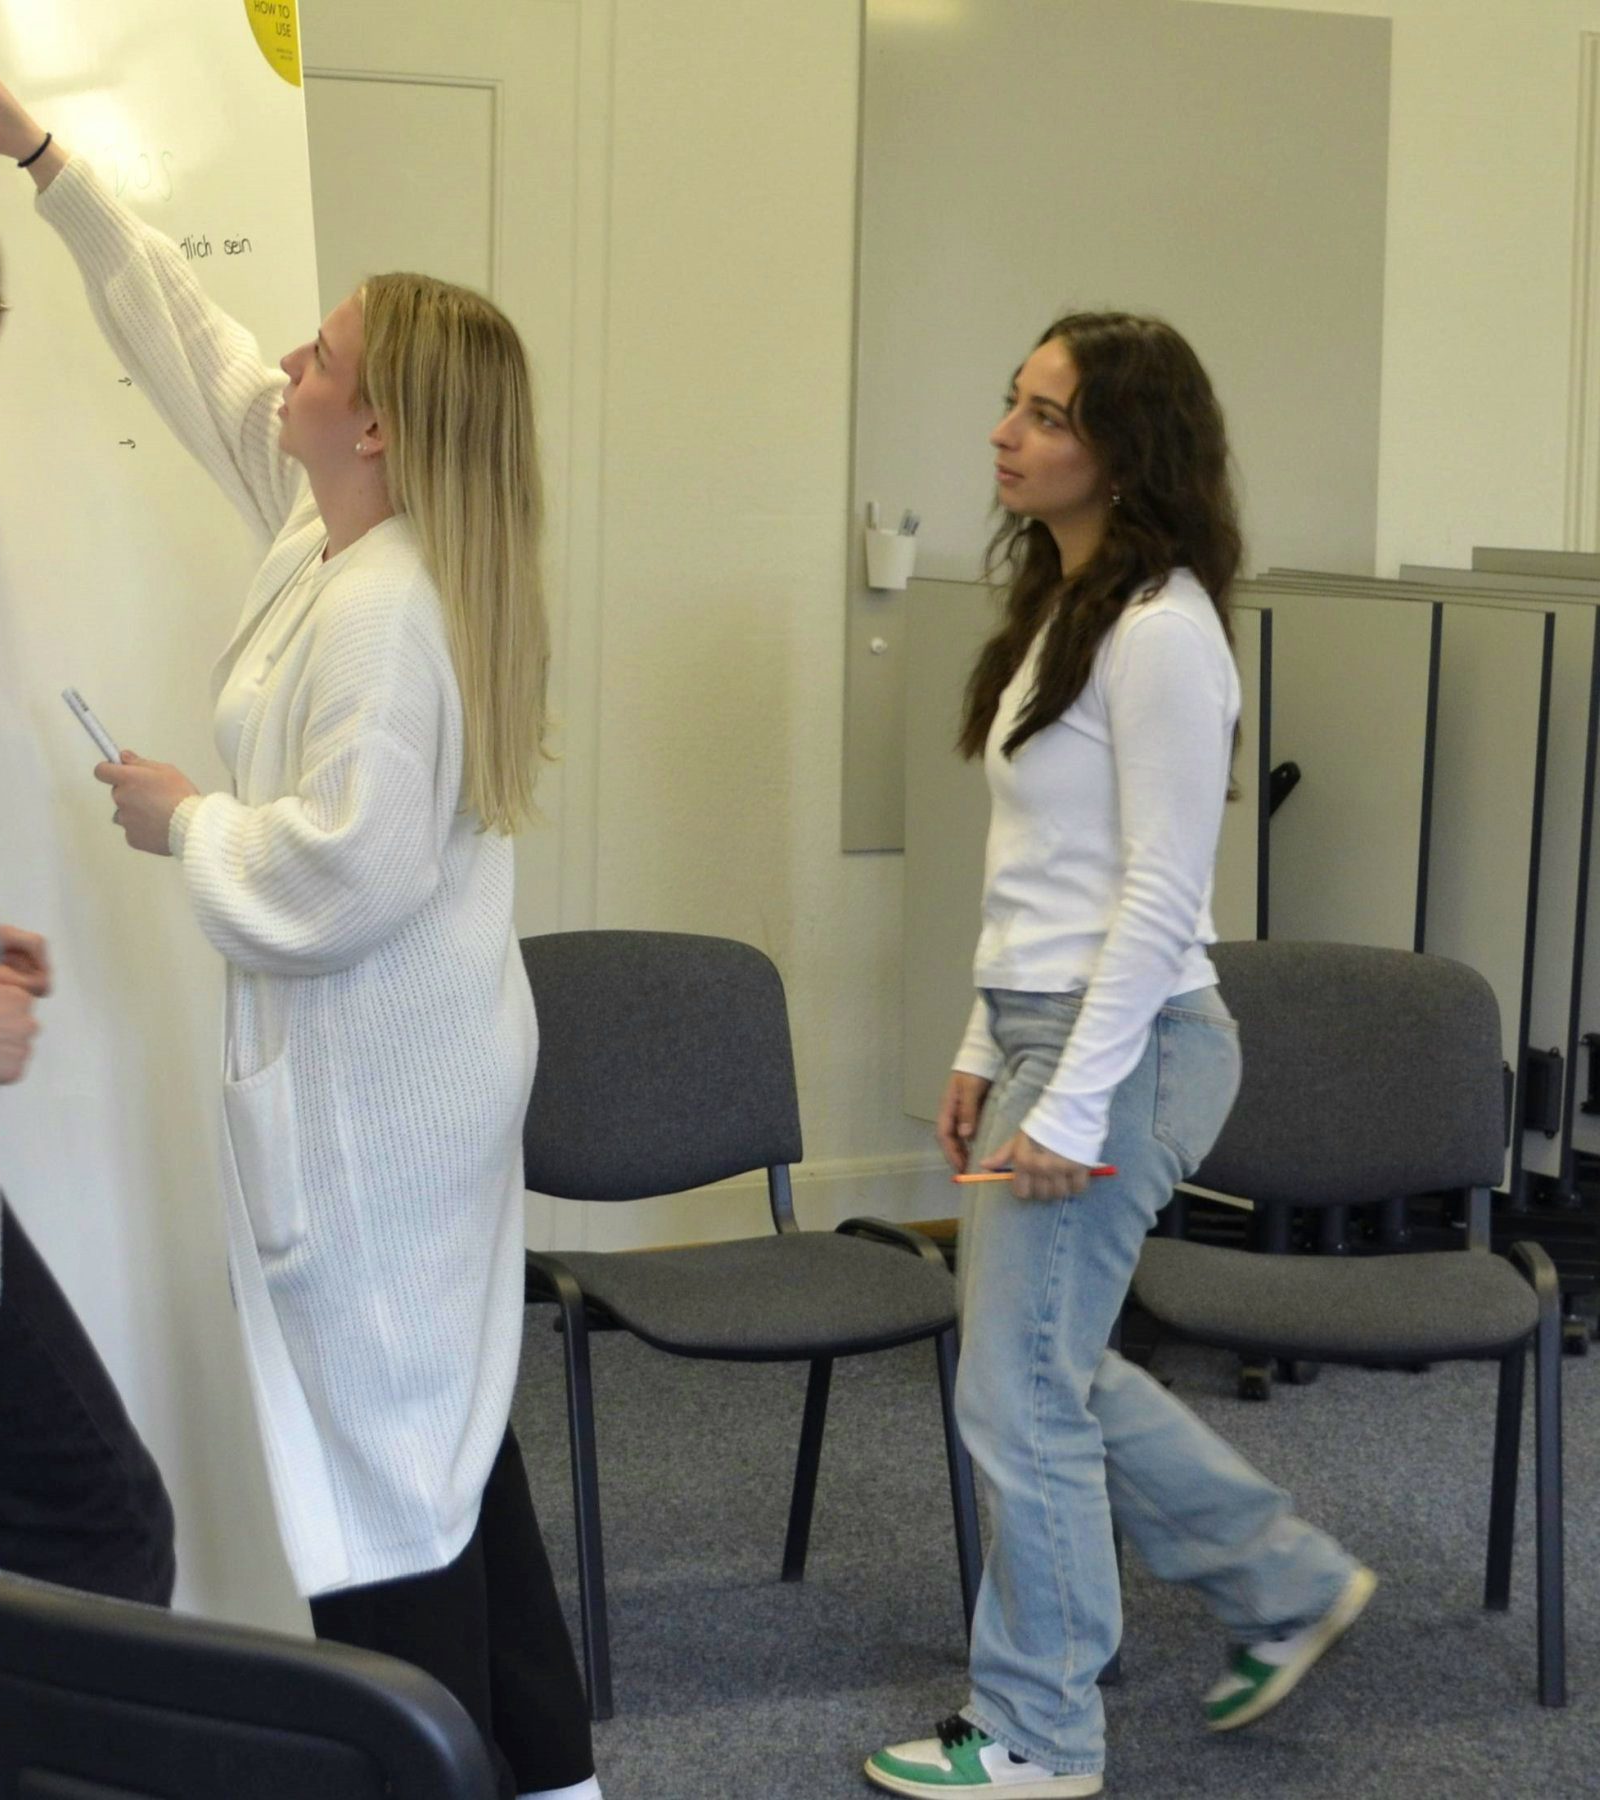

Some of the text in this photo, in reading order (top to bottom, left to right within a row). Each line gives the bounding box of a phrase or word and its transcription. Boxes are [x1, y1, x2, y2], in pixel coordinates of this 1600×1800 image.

[254, 0, 290, 19] HOW TO
[275, 22, 292, 38] USE
